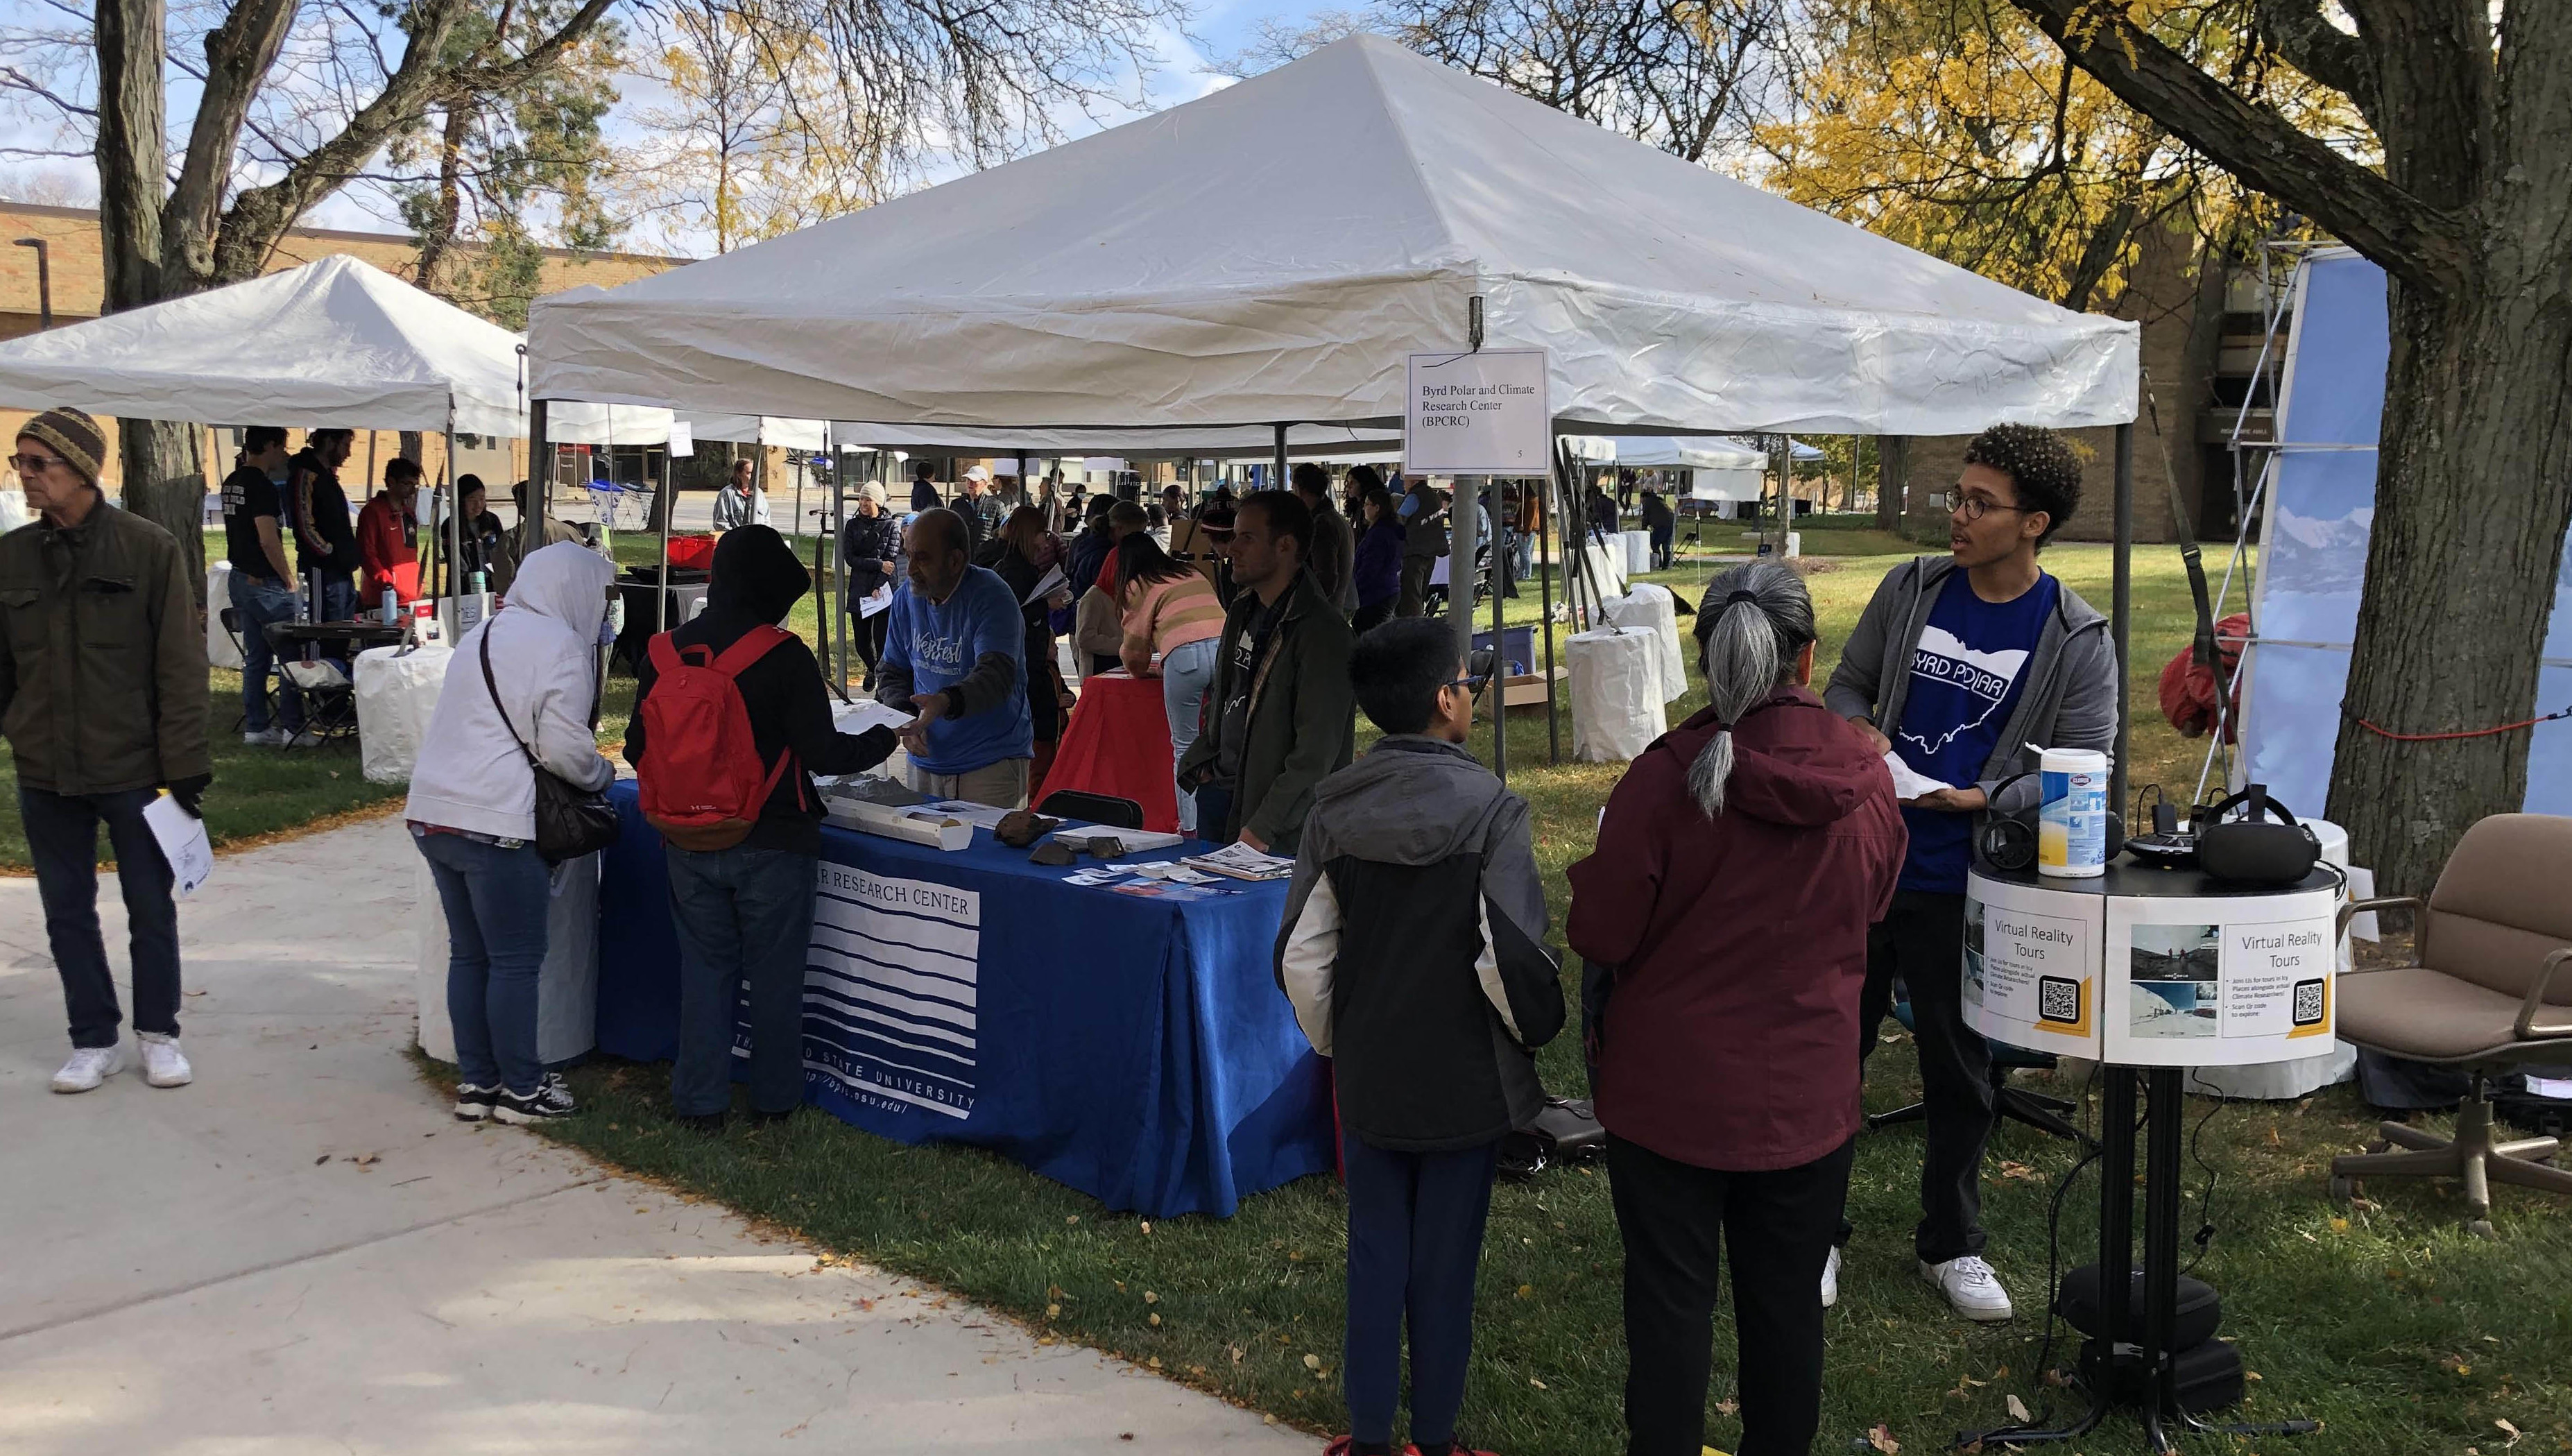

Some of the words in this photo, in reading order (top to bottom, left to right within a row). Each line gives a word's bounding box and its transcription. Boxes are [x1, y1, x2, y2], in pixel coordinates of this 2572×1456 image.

[1422, 386, 1447, 398] Byrd
[1450, 385, 1476, 396] Polar
[1479, 384, 1495, 395] and
[1498, 384, 1535, 395] Climate
[1422, 400, 1467, 412] Research
[1470, 400, 1502, 411] Center
[1422, 416, 1470, 428] (BPCRC)
[1953, 663, 2003, 696] POLAR
[834, 872, 907, 902] RESEARCH
[913, 889, 968, 915] CENTER
[1995, 919, 2027, 938] Virtual
[2031, 926, 2074, 947] Reality
[2242, 934, 2285, 950] Virtual
[2288, 930, 2322, 947] Reality
[2014, 942, 2046, 960] Tours
[2270, 954, 2300, 968] Tours
[823, 1052, 864, 1077] STATE
[876, 1071, 975, 1109] UNIVERSITY
